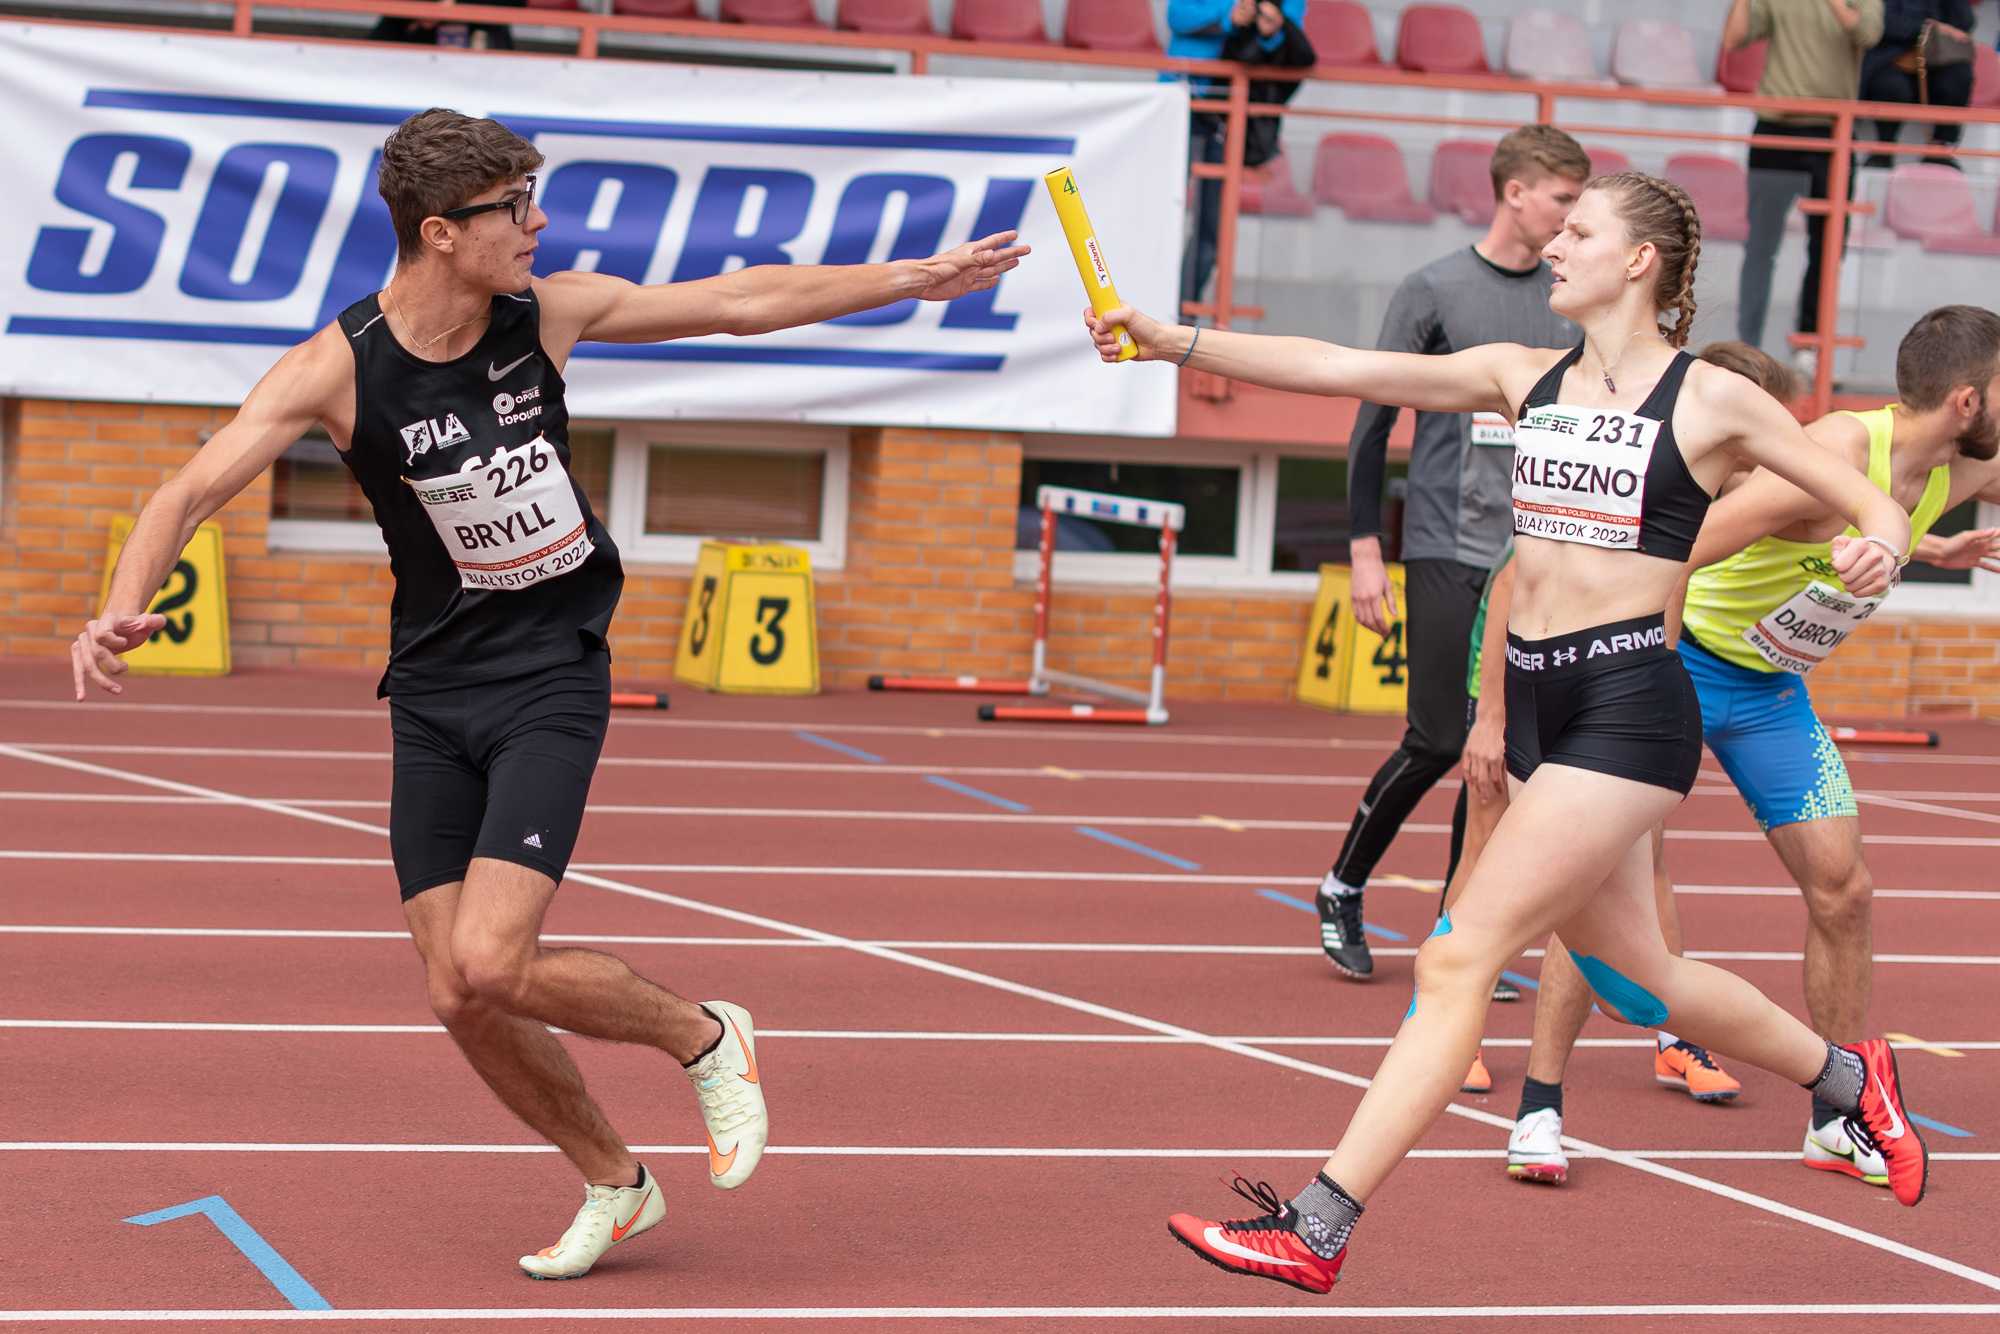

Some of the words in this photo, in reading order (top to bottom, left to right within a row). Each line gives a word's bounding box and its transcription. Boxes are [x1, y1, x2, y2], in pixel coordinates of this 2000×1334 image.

[1063, 176, 1077, 195] 4
[1088, 241, 1105, 272] polanik
[515, 389, 540, 404] OPOLE
[1586, 414, 1645, 449] 231
[487, 445, 549, 498] 226
[1515, 454, 1637, 498] KLESZNO
[454, 502, 556, 550] BRYLL
[1517, 514, 1587, 537] BIAŁYSTOK
[1590, 527, 1628, 543] 2022
[1568, 509, 1589, 518] POLSKI
[465, 563, 549, 586] BIAŁYSTOK
[552, 540, 586, 571] 2022
[515, 552, 540, 565] POLSKI
[149, 559, 198, 644] 2
[690, 576, 717, 658] 3
[750, 596, 790, 666] 3
[1372, 621, 1406, 685] 4
[1505, 642, 1545, 671] NDER
[1751, 634, 1813, 674] BIAŁYSTOK
